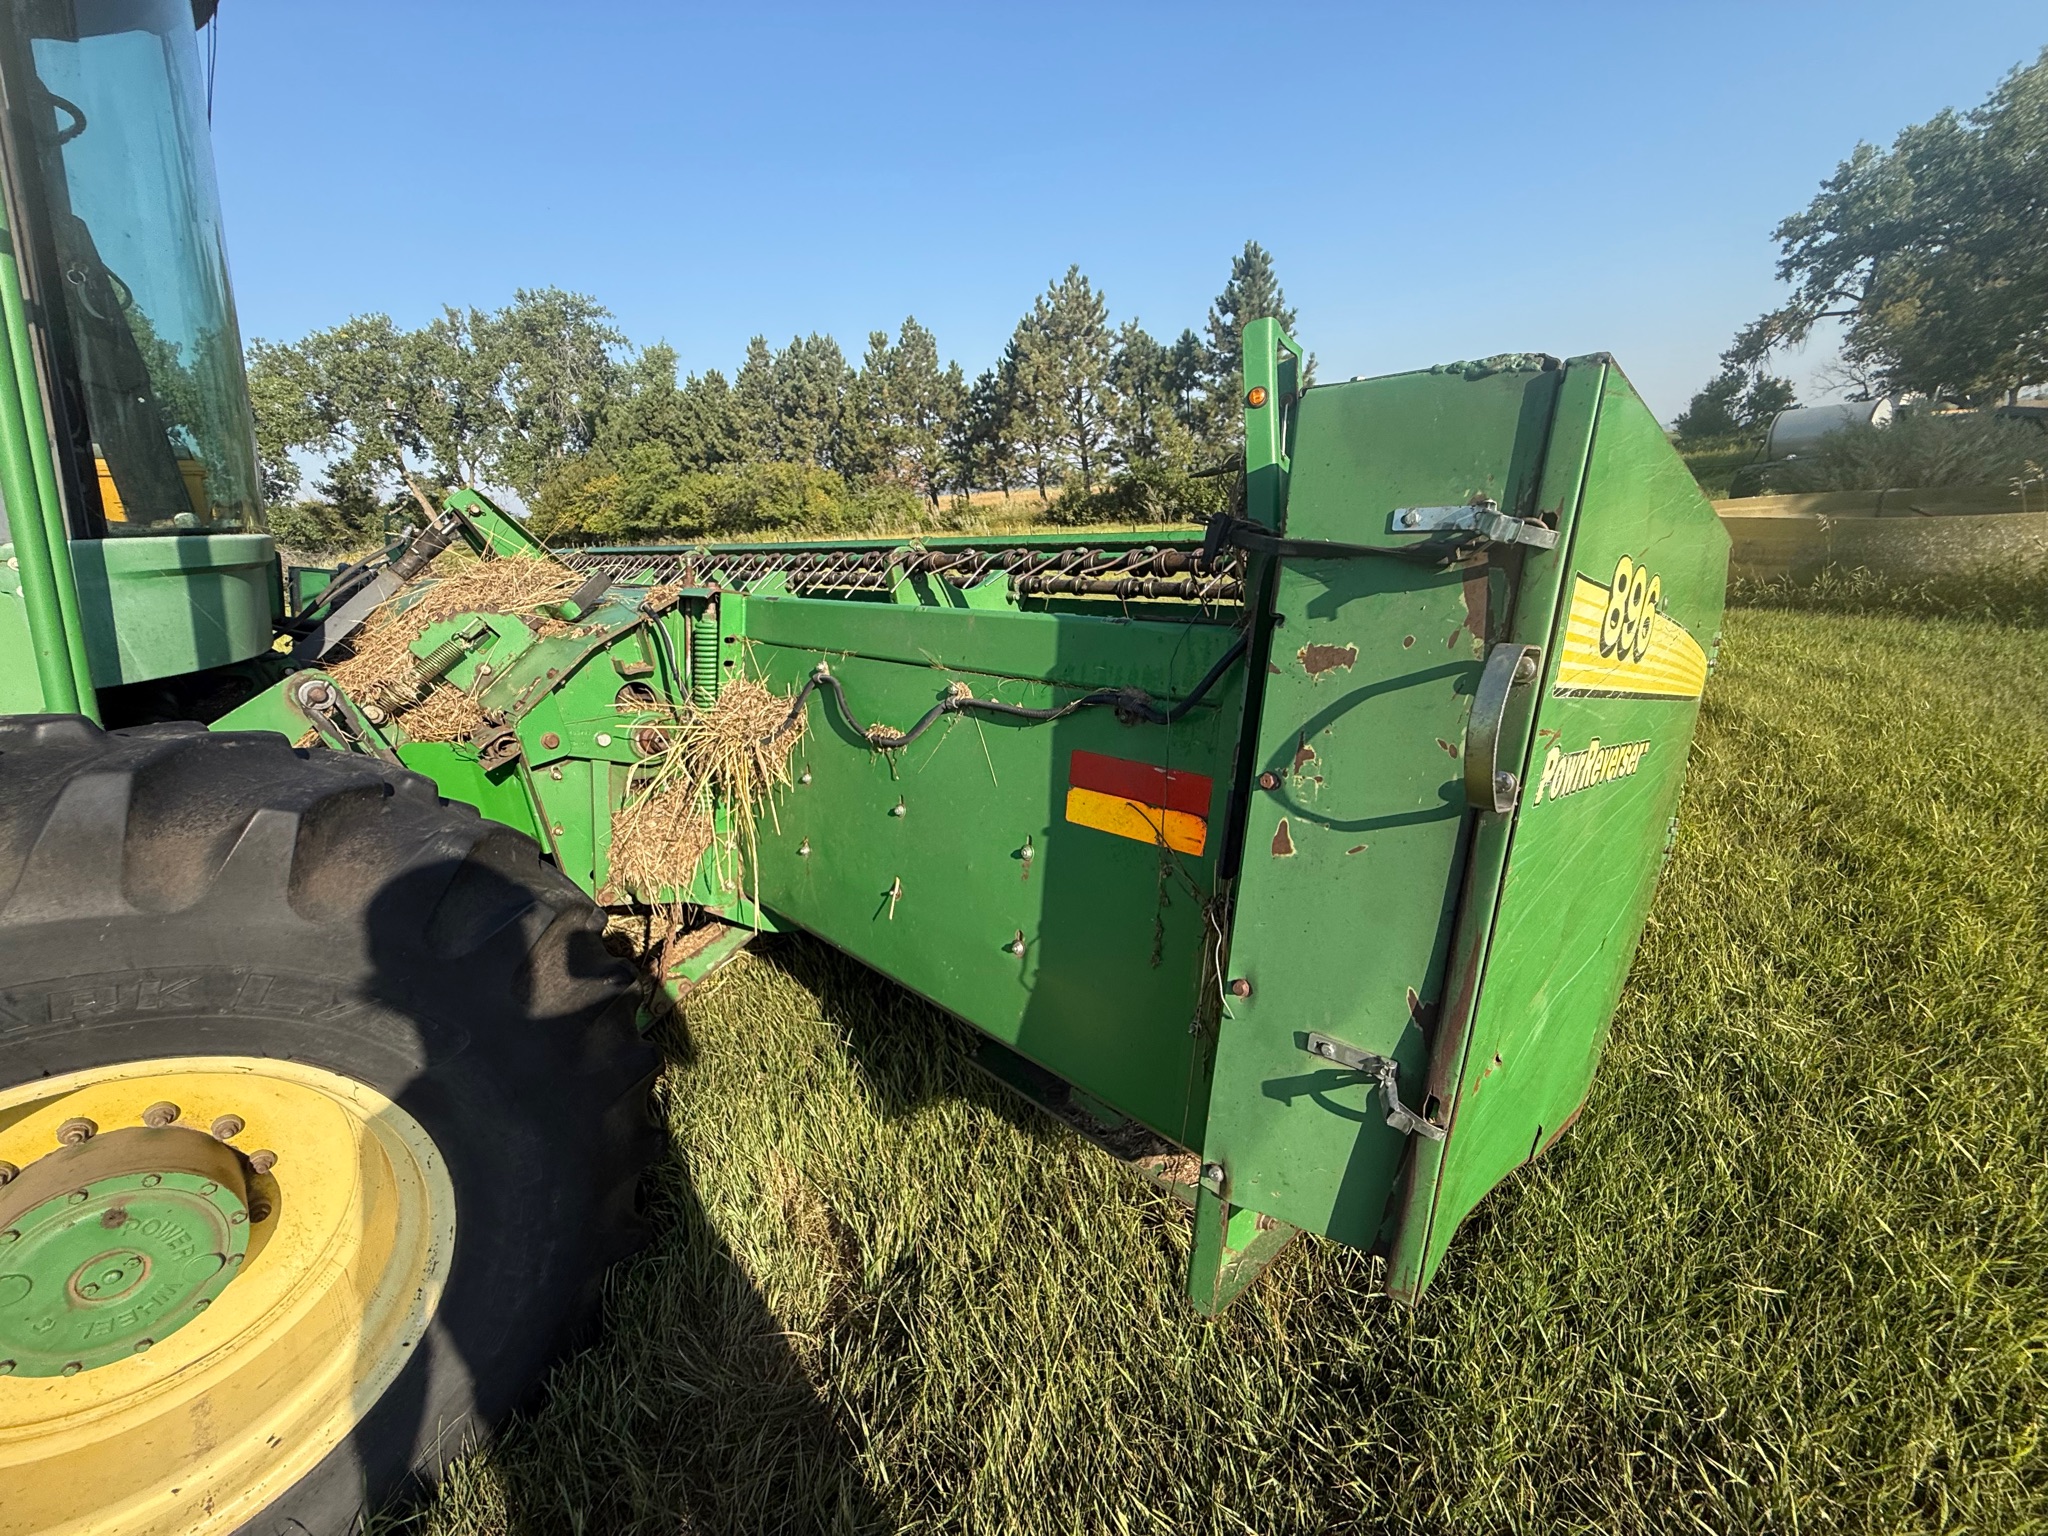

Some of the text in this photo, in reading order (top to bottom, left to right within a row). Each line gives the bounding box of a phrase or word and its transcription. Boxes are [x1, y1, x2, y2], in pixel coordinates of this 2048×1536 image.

[1599, 553, 1661, 664] 896
[77, 1217, 195, 1340] POWER WHEEL
